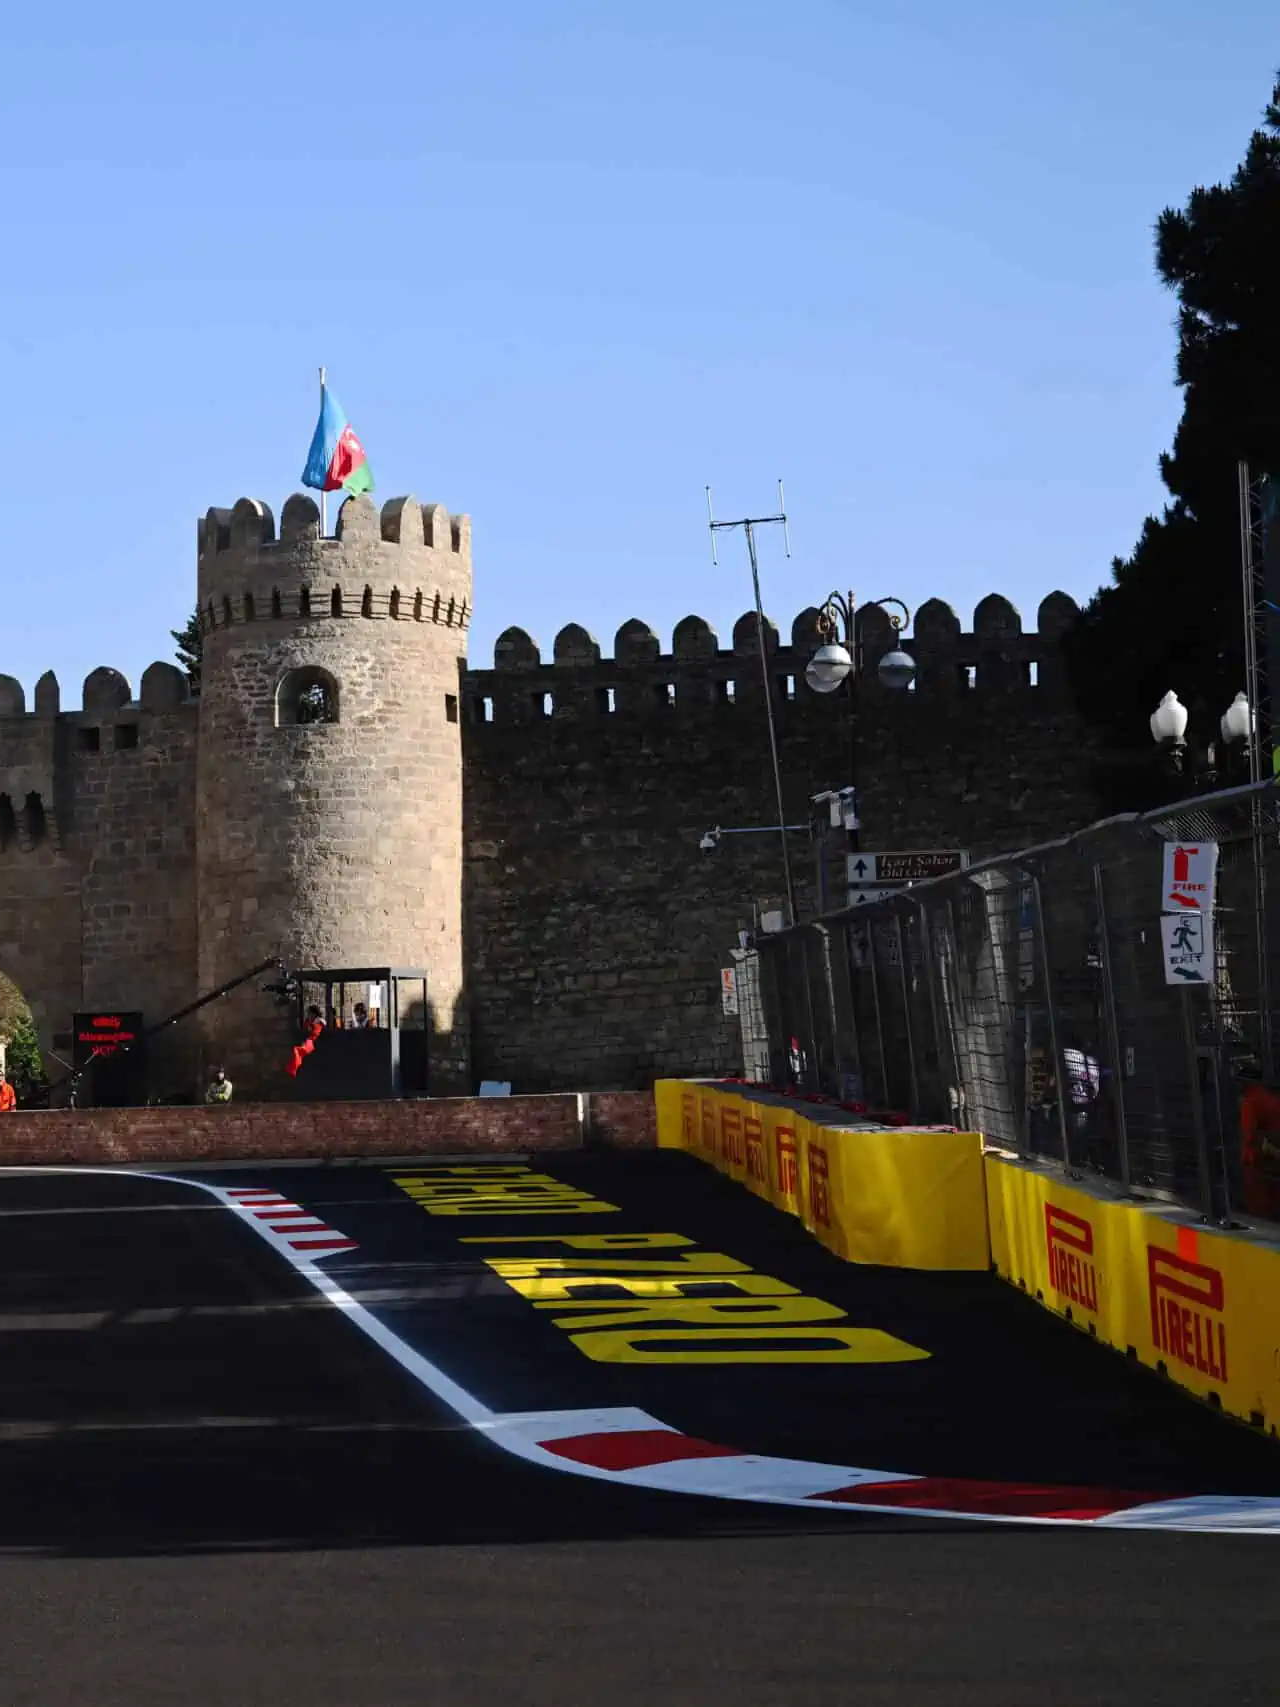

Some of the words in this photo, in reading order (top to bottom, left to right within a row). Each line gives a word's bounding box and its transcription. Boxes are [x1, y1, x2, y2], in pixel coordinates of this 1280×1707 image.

[1169, 954, 1202, 965] EXIT
[1045, 1201, 1098, 1313] PIRELLI
[1147, 1244, 1228, 1384] PIRELLI
